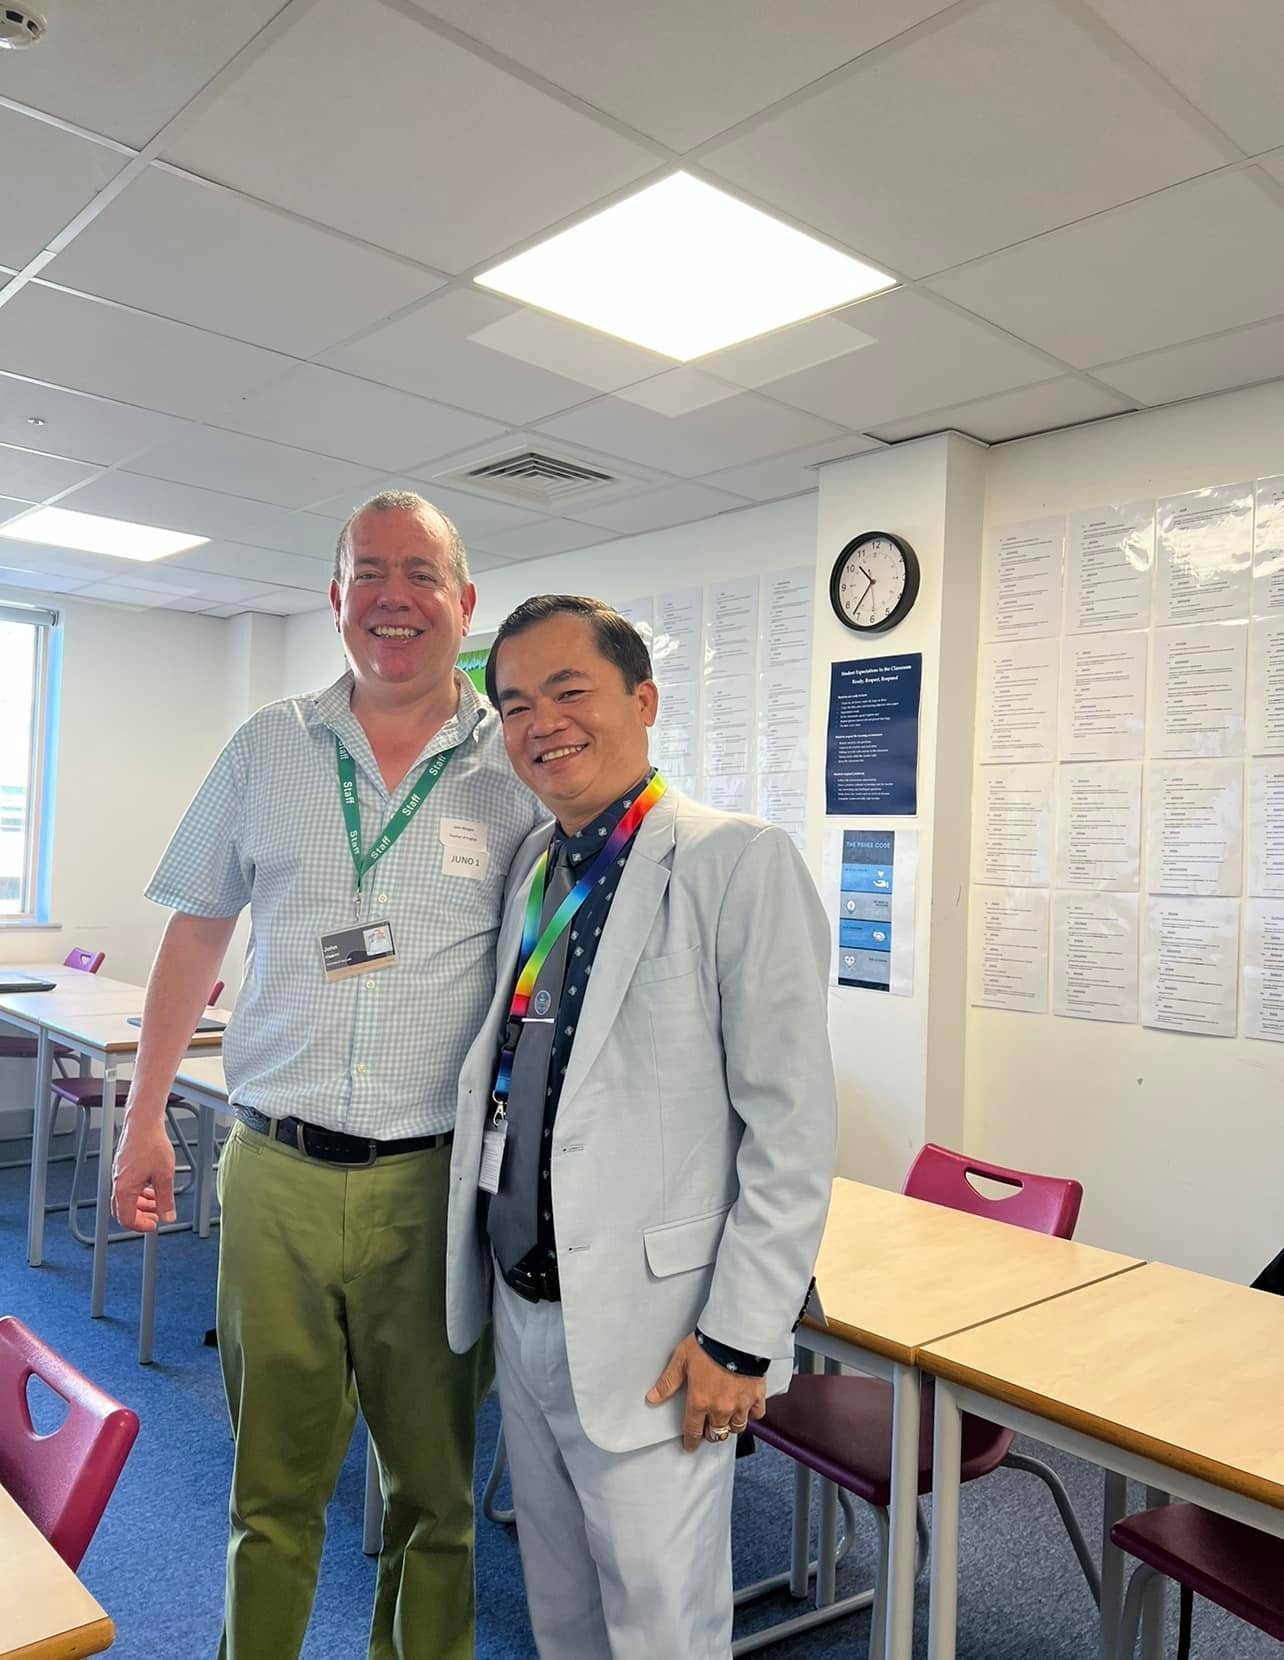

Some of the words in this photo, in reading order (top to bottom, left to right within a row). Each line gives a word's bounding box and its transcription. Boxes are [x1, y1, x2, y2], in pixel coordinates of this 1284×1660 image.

[858, 549, 866, 558] 11
[872, 540, 880, 550] 12
[846, 564, 856, 574] 10
[428, 754, 447, 776] Staff
[343, 781, 355, 804] Staff
[401, 793, 421, 816] Staff
[350, 830, 360, 855] Staff
[370, 835, 391, 860] Staff
[451, 855, 474, 865] JUNO
